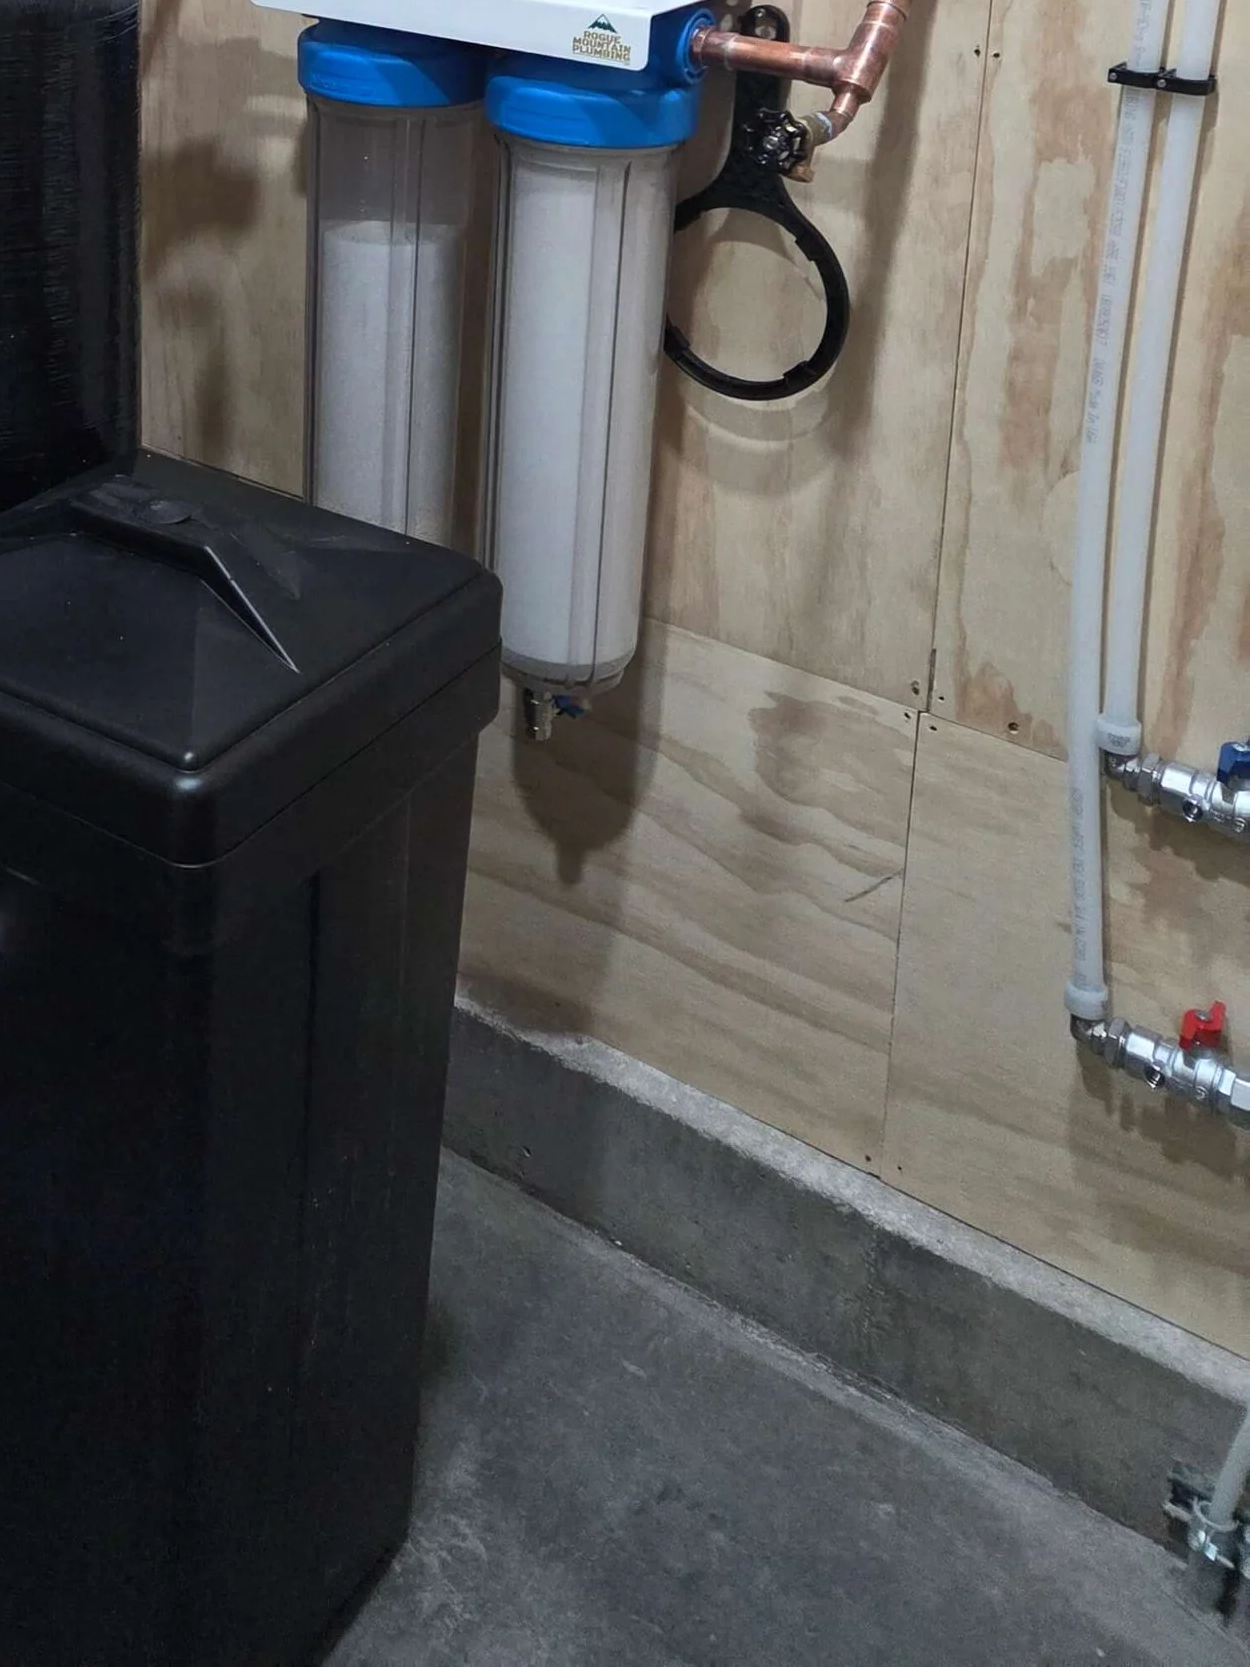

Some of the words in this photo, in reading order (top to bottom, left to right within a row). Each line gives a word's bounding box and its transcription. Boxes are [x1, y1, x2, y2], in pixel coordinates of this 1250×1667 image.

[572, 36, 631, 53] MOUNTAIN
[583, 30, 622, 45] ROGUE
[572, 44, 631, 62] PLUMBING
